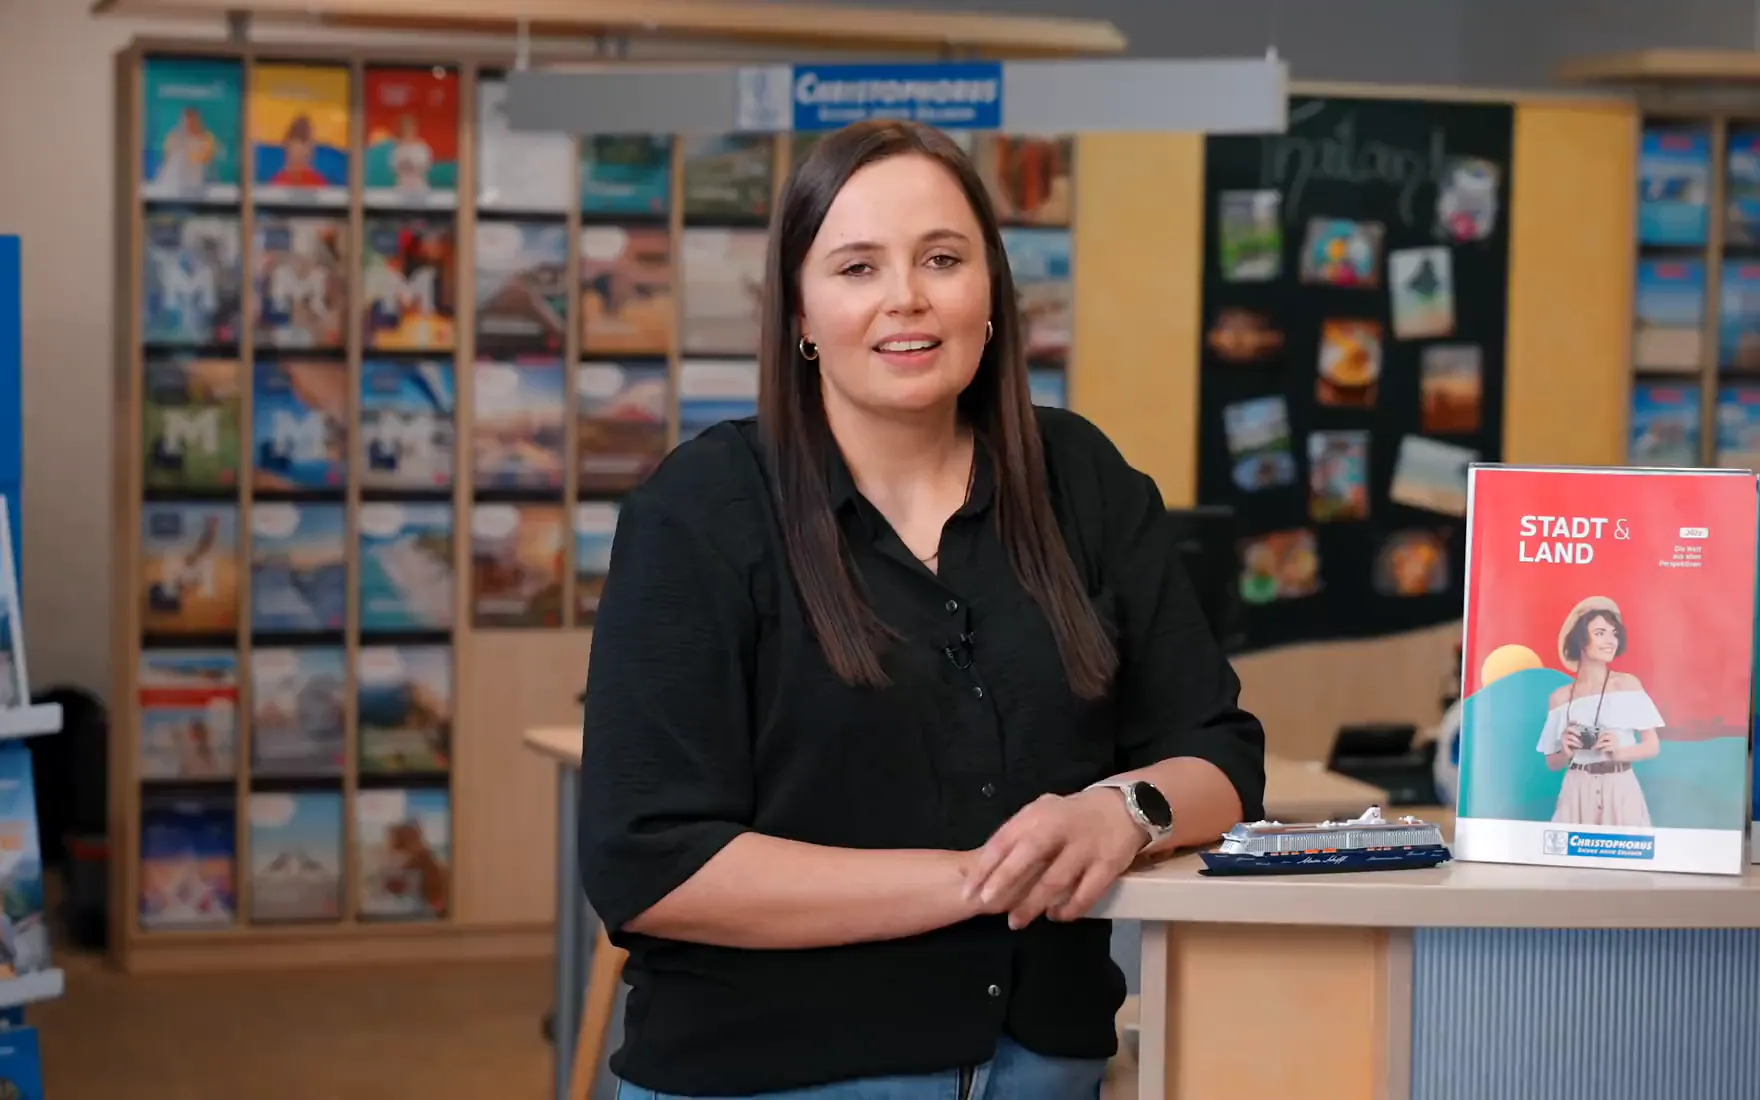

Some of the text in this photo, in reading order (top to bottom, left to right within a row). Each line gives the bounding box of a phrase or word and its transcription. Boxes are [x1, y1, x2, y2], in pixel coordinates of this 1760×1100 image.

[271, 264, 328, 316] M
[162, 407, 220, 456] M
[1519, 514, 1631, 540] STADT &
[1518, 540, 1595, 564] LAND
[1569, 835, 1653, 850] CHRISTOPHORUS
